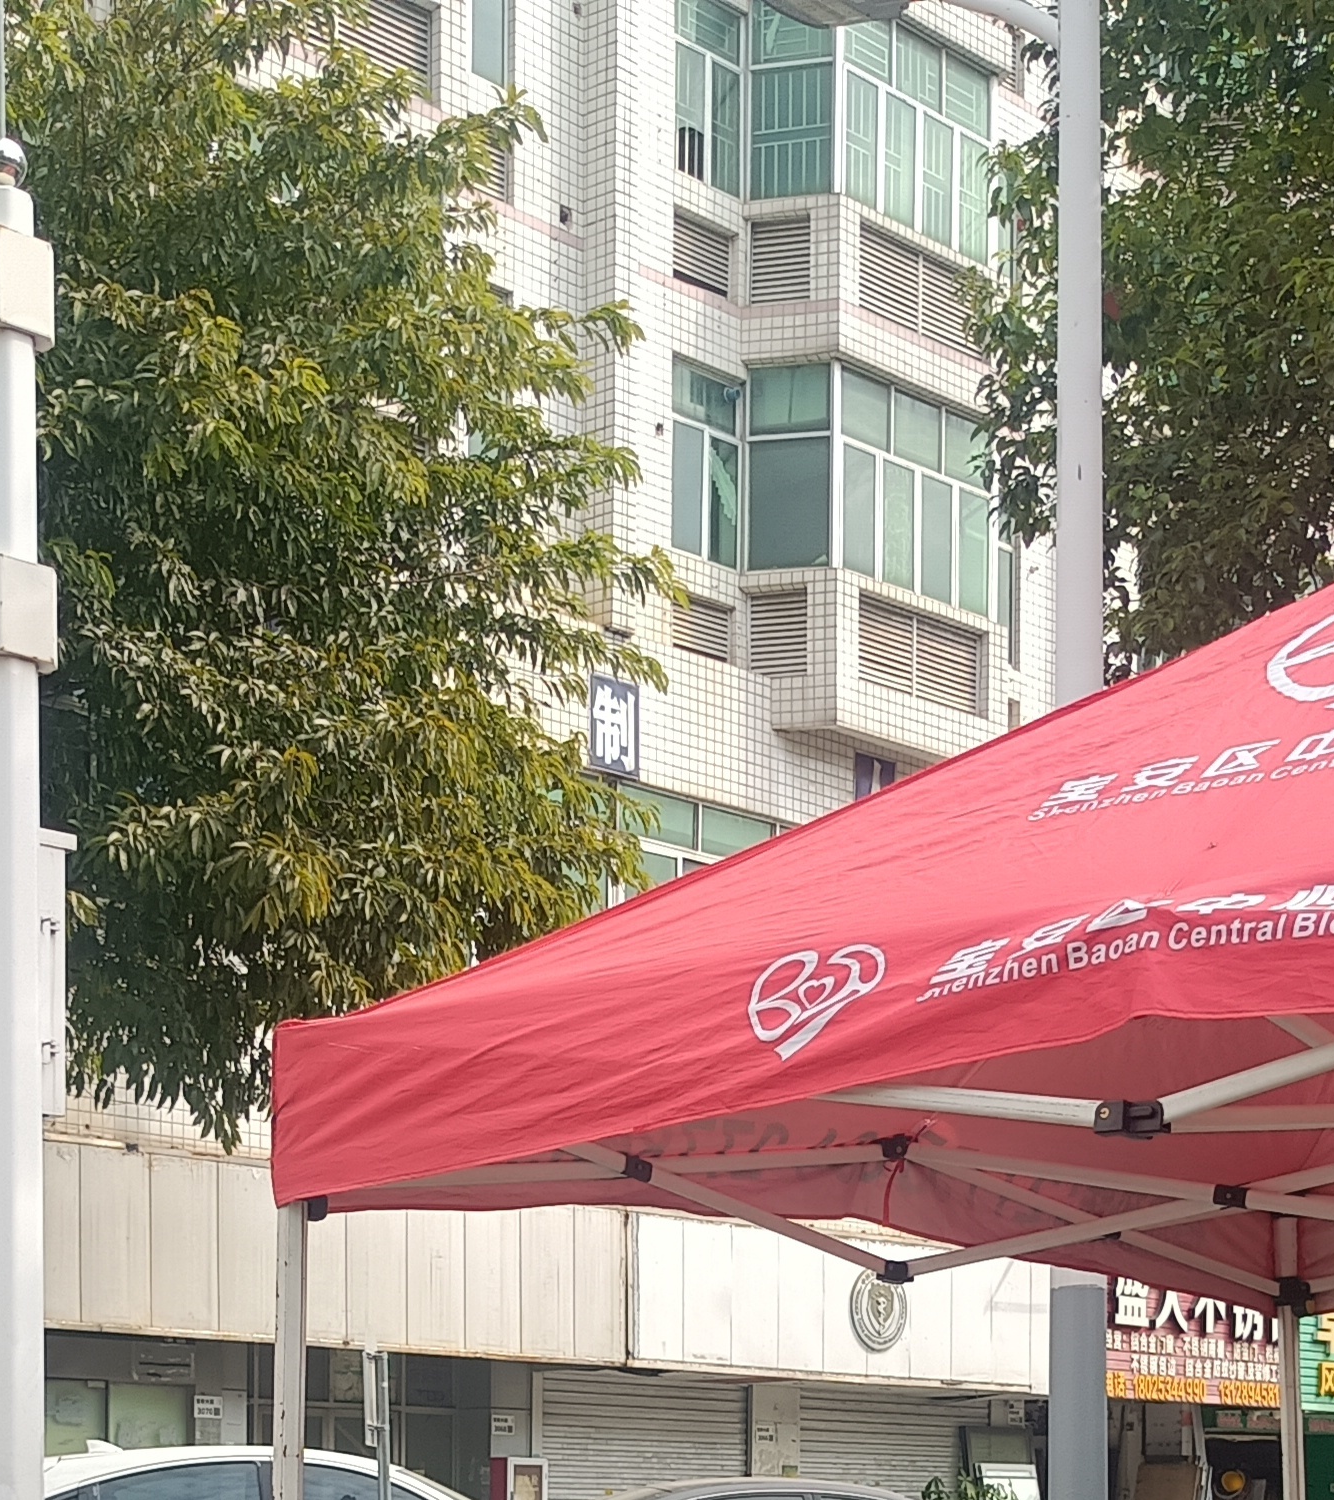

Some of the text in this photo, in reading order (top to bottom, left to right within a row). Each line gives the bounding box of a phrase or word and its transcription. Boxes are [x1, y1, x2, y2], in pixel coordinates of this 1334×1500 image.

[593, 684, 635, 772] 制
[1028, 788, 1164, 823] Shenzhen
[1175, 772, 1265, 797] Baoan
[1065, 928, 1161, 971] Baoan
[1167, 912, 1287, 952] Central
[1133, 1374, 1207, 1402] 18025344990
